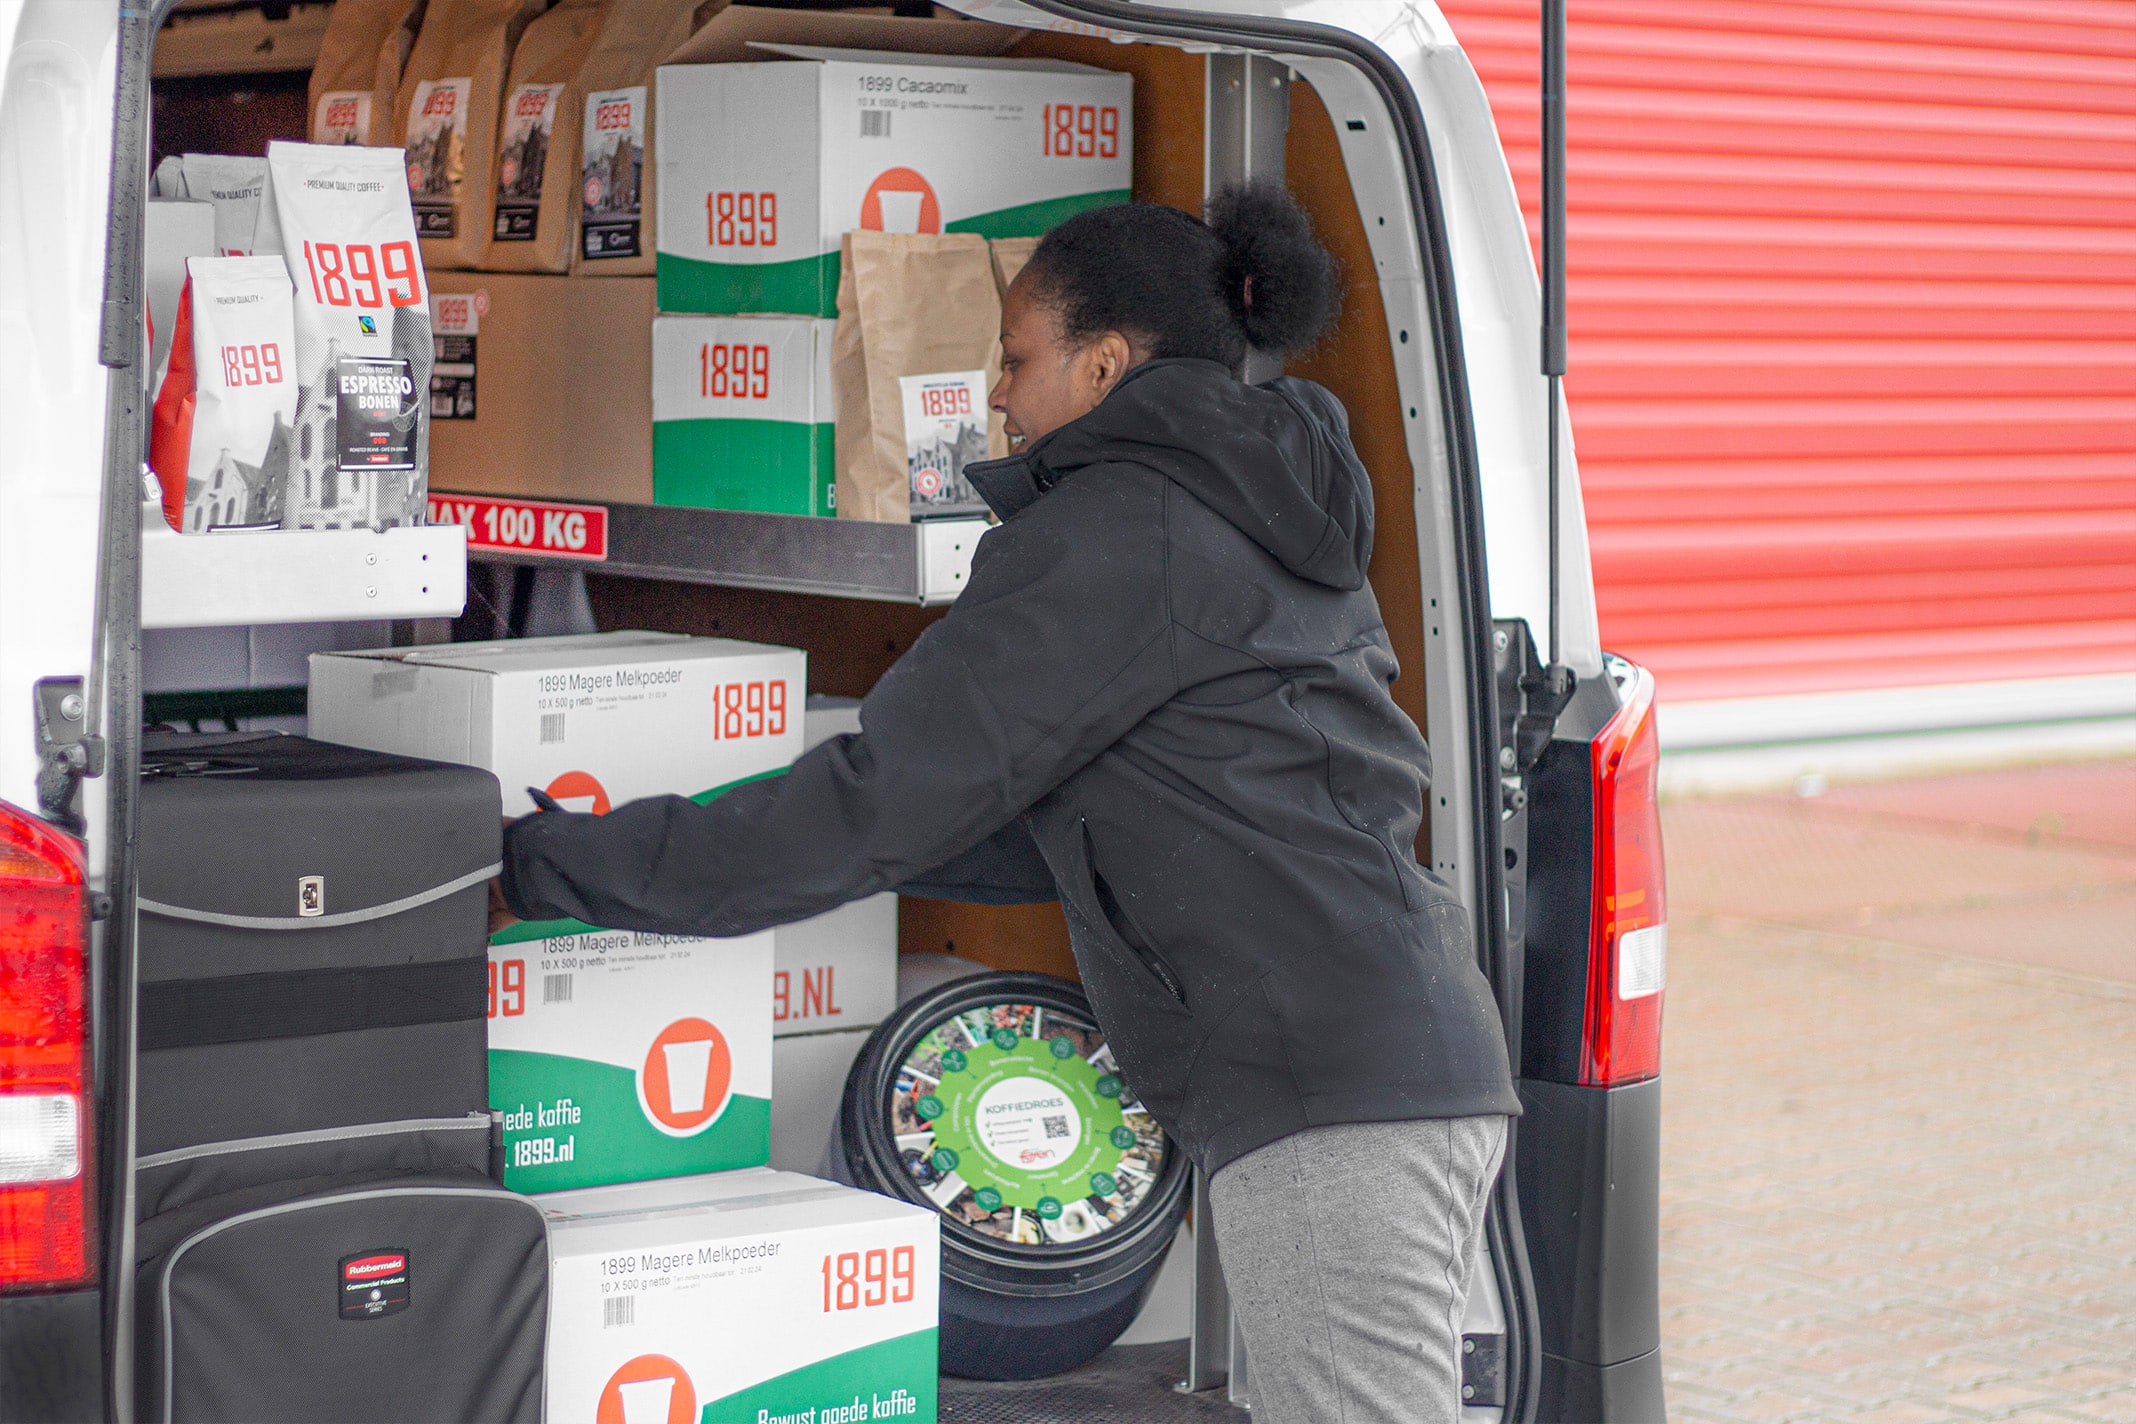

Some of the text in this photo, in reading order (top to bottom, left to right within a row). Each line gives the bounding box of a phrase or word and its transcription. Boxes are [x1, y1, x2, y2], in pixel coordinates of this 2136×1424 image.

[857, 76, 968, 95] 1899 Cacaomix
[1043, 103, 1118, 158] 1899
[356, 182, 381, 192] COFFEE
[706, 191, 777, 246] 1899
[303, 239, 421, 308] 1899
[221, 342, 283, 387] 1899
[358, 366, 393, 374] DARK ROAST
[702, 343, 768, 398] 1899
[341, 375, 412, 395] ESPRESSO
[359, 395, 399, 409] BONEN
[921, 387, 971, 417] 1899
[484, 506, 535, 545] 100
[543, 511, 587, 549] KG
[539, 667, 682, 693] 1899 Magere Melkpoeder
[555, 697, 568, 707] 500
[576, 697, 593, 706] netto
[714, 680, 786, 740] 1899
[541, 936, 575, 954] 1899
[579, 935, 629, 953] Magere
[541, 960, 550, 970] 10
[554, 959, 560, 969] X
[562, 957, 577, 969] 500
[579, 959, 584, 970] g
[586, 957, 607, 967] netto
[503, 1098, 581, 1131] ede koffie
[985, 1097, 1064, 1115] KOFFIEDROES
[515, 1135, 575, 1167] 1899.nl
[349, 1259, 402, 1275] Rubbermaid
[601, 1240, 781, 1276] 1899 Magere Melkpoeder
[346, 1277, 405, 1291] Commercial Products
[601, 1282, 611, 1293] 10
[614, 1281, 620, 1292] X
[622, 1279, 638, 1291] 500
[641, 1280, 647, 1291] g
[649, 1275, 671, 1287] netto
[821, 1245, 914, 1313] 1899
[873, 1388, 917, 1419] koffie
